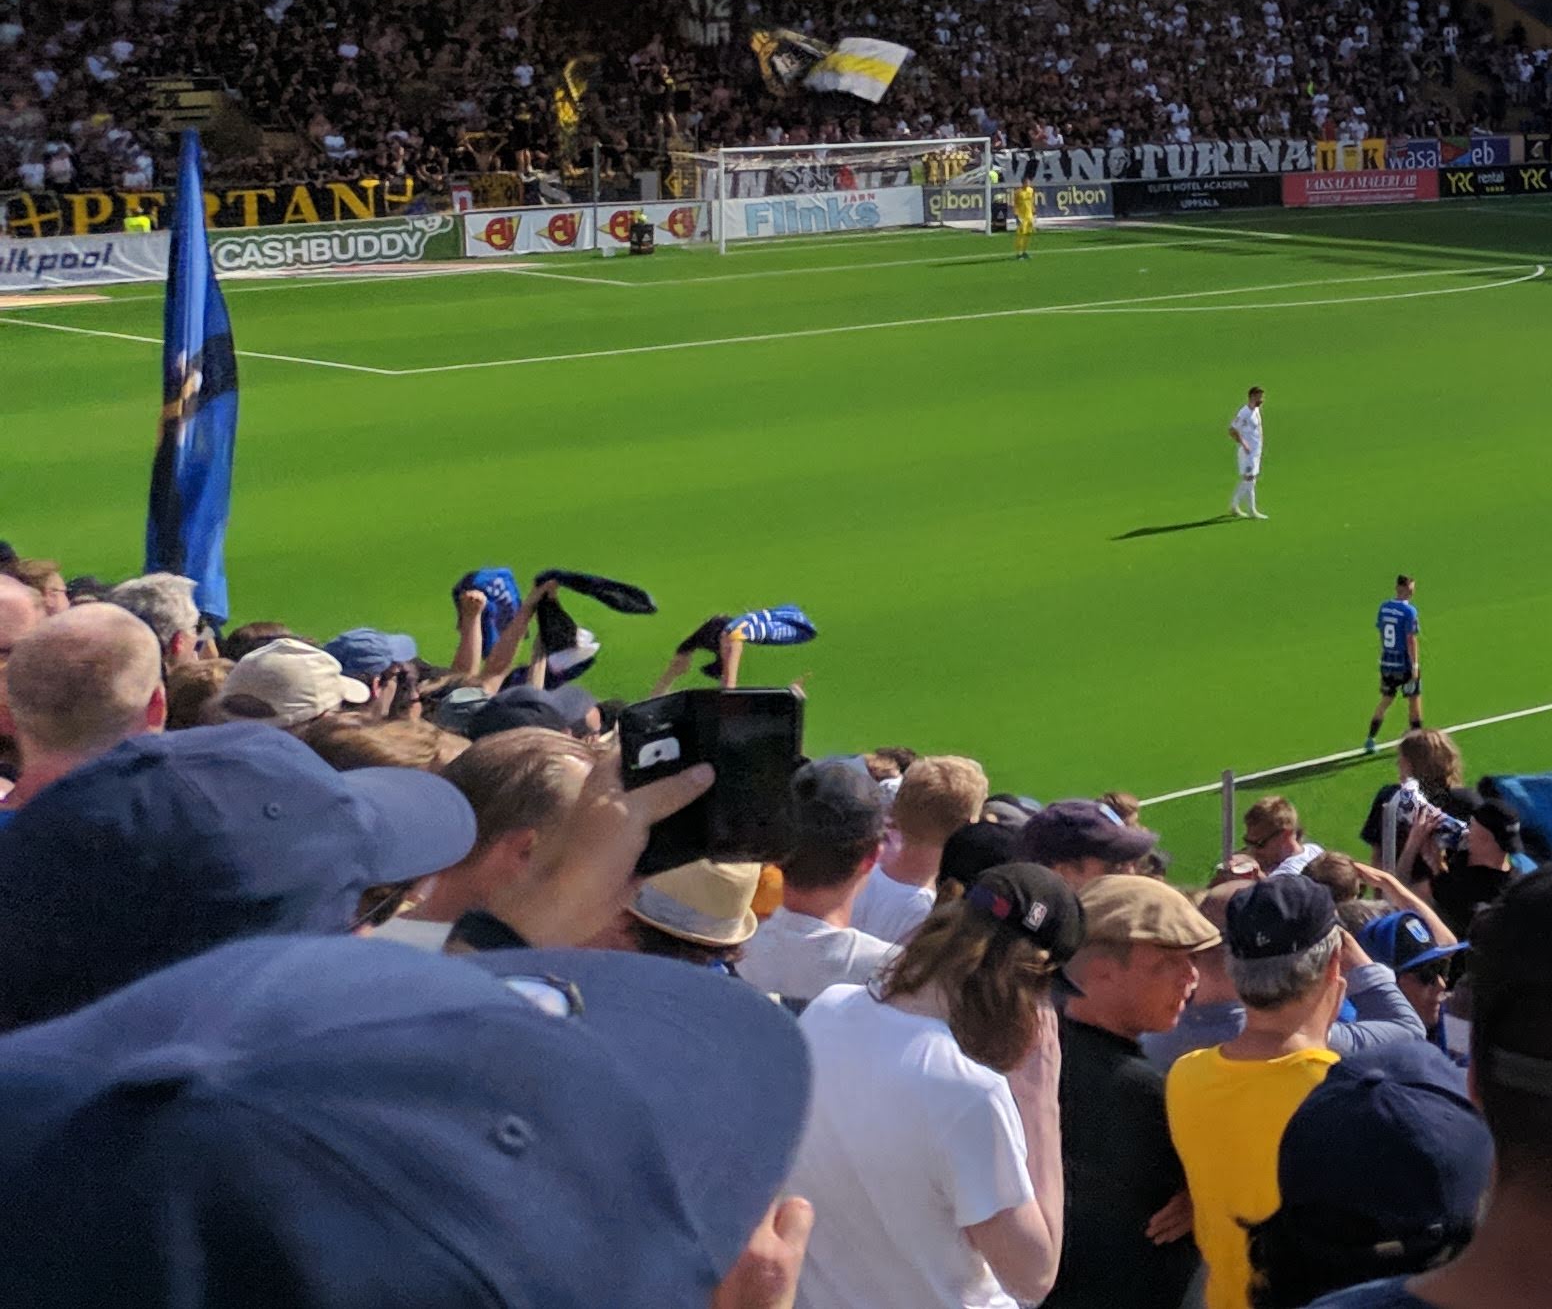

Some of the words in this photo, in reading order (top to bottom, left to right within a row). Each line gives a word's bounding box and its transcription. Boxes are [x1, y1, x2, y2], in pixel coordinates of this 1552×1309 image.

[1133, 139, 1309, 179] TURINA
[1173, 182, 1201, 191] HOTEL
[1447, 172, 1474, 193] YRC
[1520, 168, 1547, 189] YRC
[929, 190, 983, 220] gibon
[1057, 186, 1106, 215] gibon
[745, 197, 880, 236] Flinks
[0, 243, 113, 280] lkpool
[217, 231, 422, 269] CASHBUDDY
[1384, 624, 1396, 648] 9
